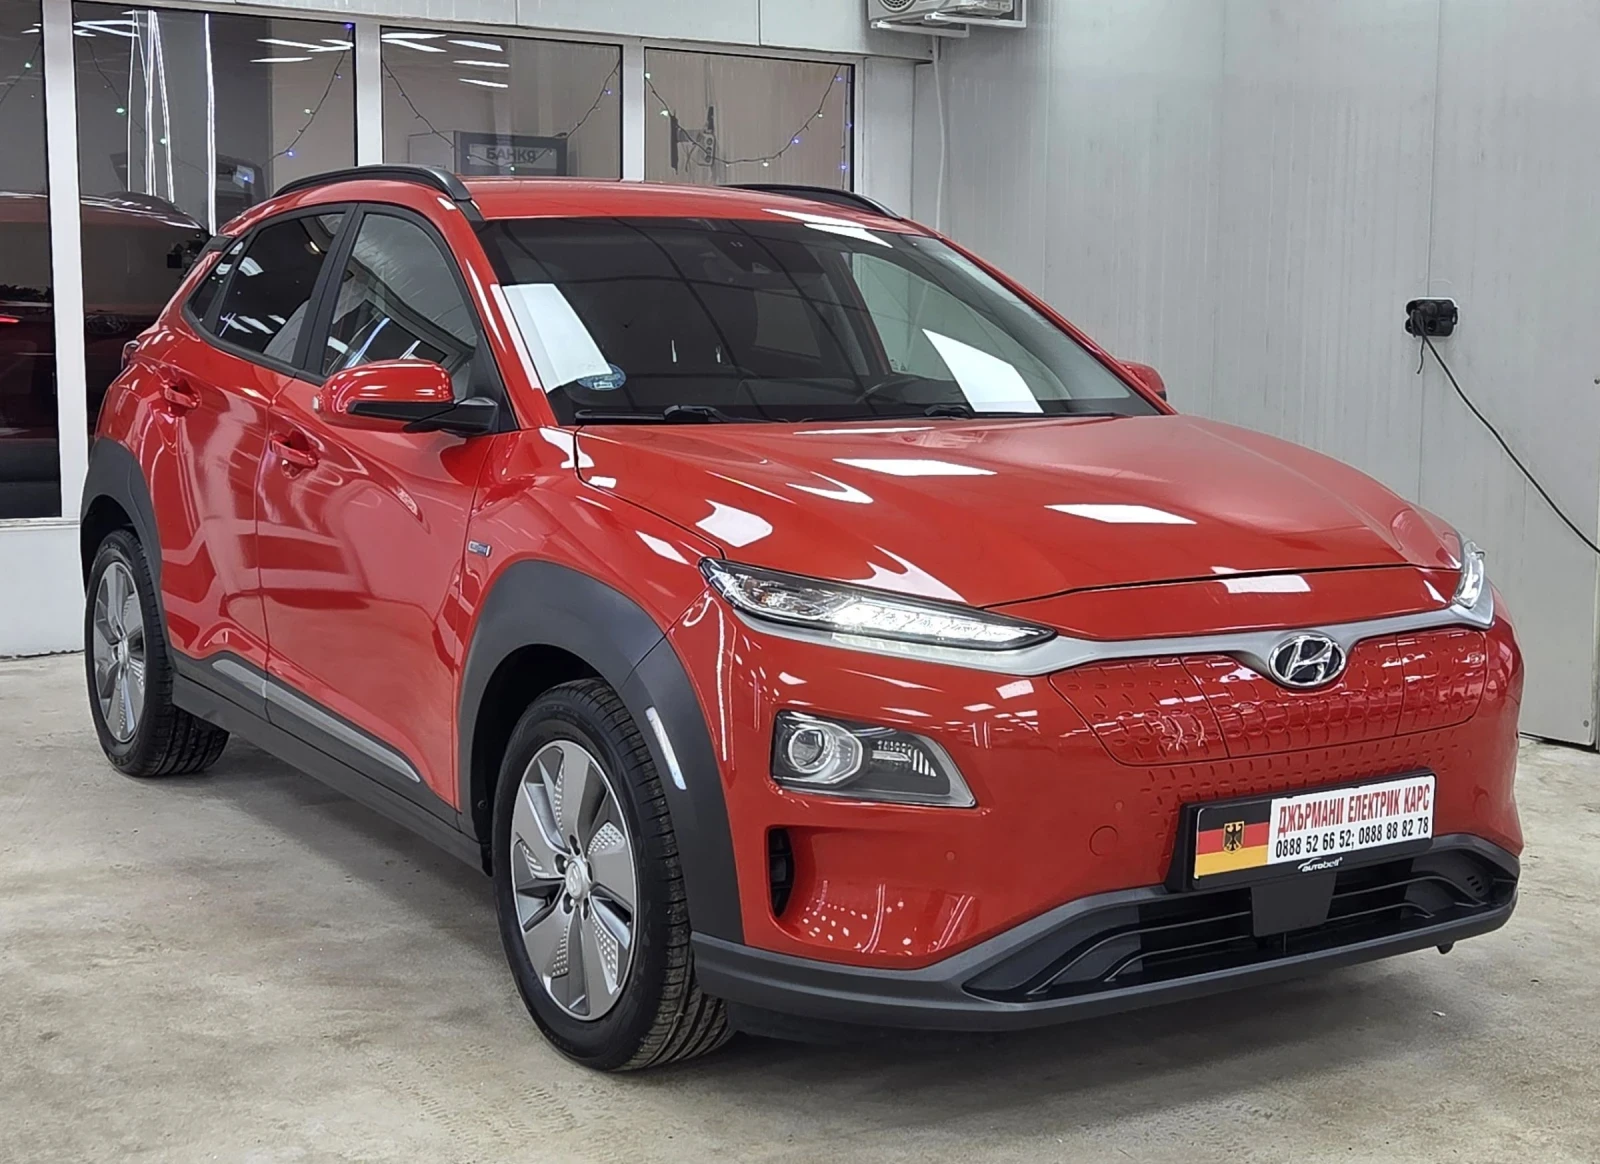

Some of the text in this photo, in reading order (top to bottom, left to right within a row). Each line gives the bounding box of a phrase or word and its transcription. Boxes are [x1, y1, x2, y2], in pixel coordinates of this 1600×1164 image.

[1277, 784, 1430, 838] ДЖЪРМАНИ ЕЛЕКТРИК КАРС
[1275, 816, 1429, 858] 0888 52 66 52; 0888 88 82 78
